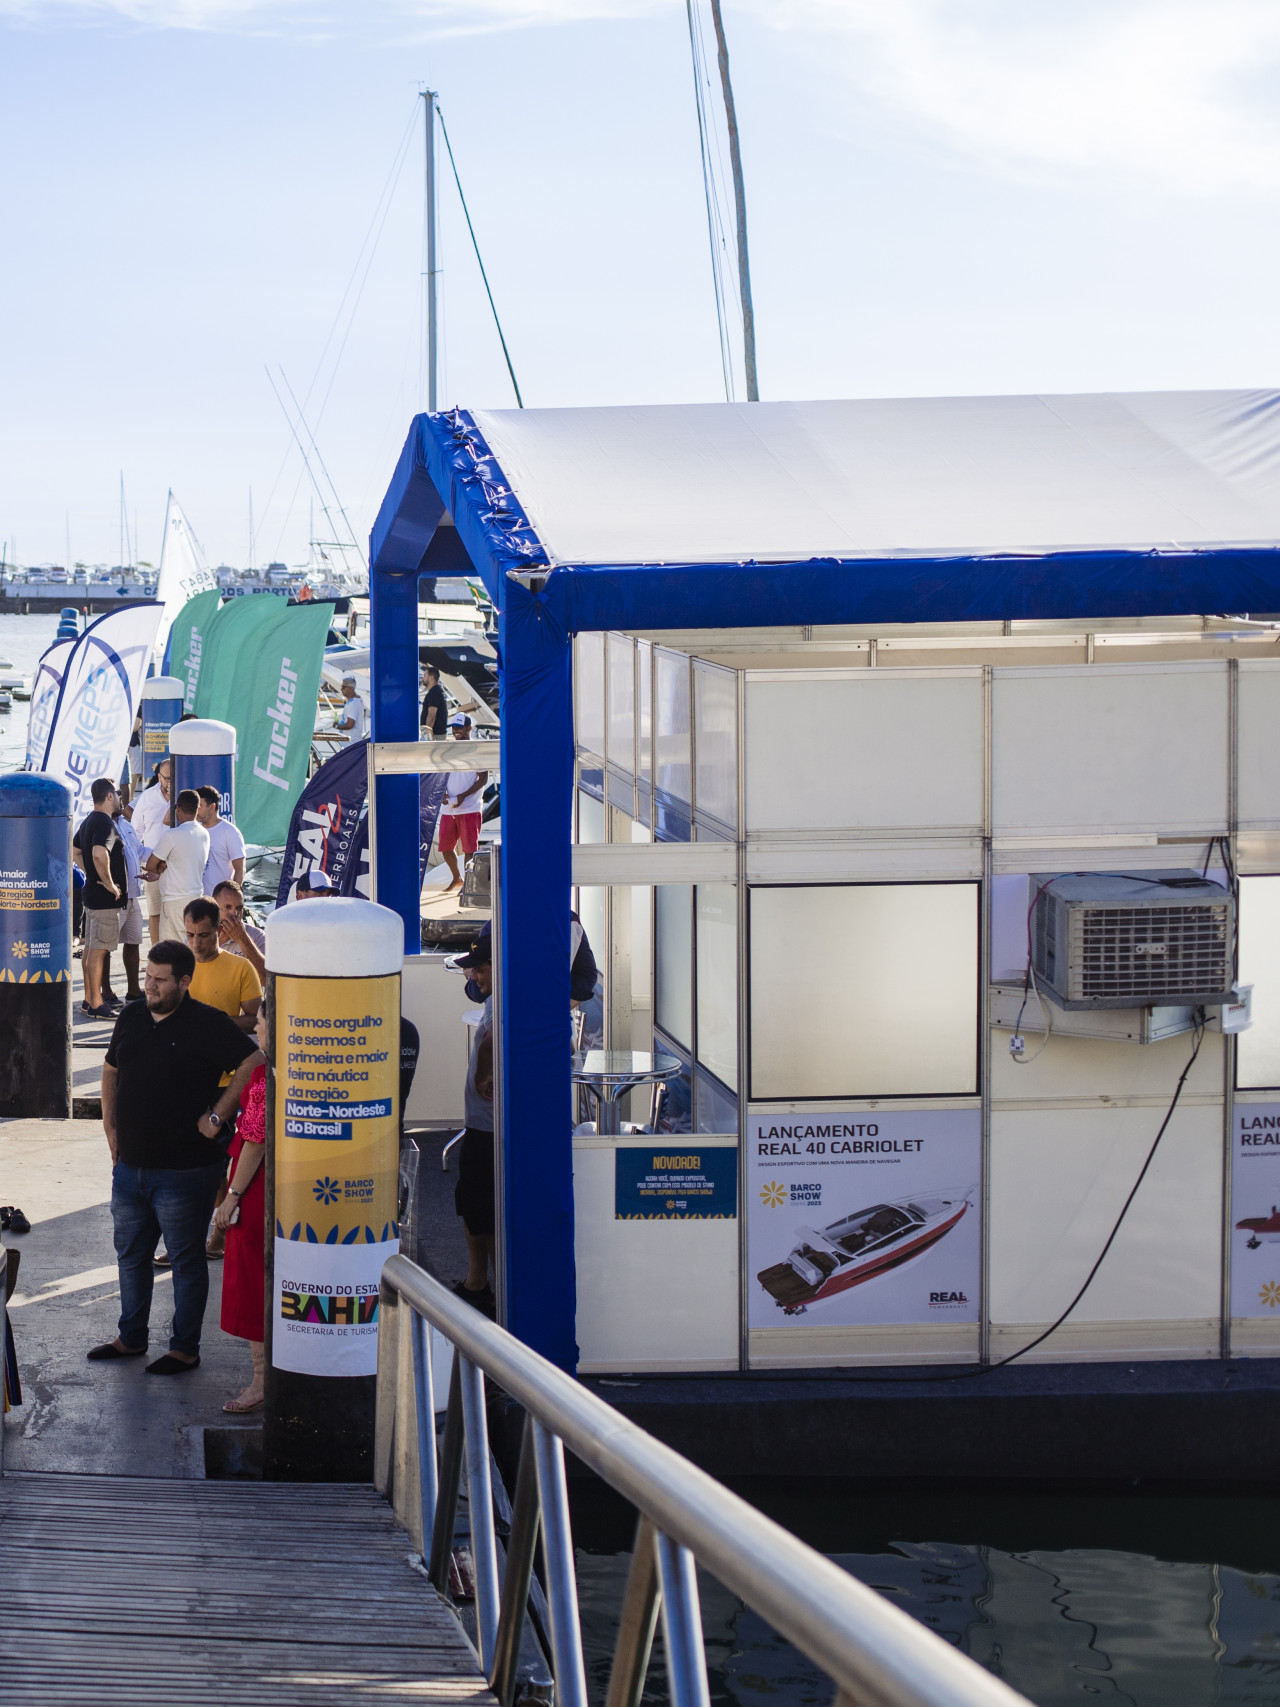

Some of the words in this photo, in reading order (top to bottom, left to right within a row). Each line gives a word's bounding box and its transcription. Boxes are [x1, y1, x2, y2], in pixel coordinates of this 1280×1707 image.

[253, 657, 298, 791] Focker
[2, 869, 28, 879] maior
[14, 879, 48, 889] náutica
[7, 890, 33, 900] região
[288, 1014, 332, 1028] Temos
[333, 1015, 383, 1032] orgulho
[288, 1032, 303, 1045] de
[304, 1035, 356, 1046] sermos
[357, 1036, 367, 1046] a
[288, 1049, 344, 1065] primeira
[345, 1054, 354, 1064] e
[355, 1049, 389, 1063] maior
[288, 1067, 315, 1081] feira
[316, 1068, 369, 1082] náutica
[288, 1085, 304, 1098] da
[305, 1086, 350, 1103] região
[287, 1120, 303, 1134] do
[303, 1121, 342, 1136] Brasil
[758, 1123, 879, 1142] LANÇAMENTO
[758, 1143, 802, 1156] REAL
[805, 1142, 826, 1155] 40
[831, 1139, 924, 1154] CABRIOLET
[652, 1155, 701, 1170] NOVIDADE!
[344, 1179, 374, 1188] BARCO
[790, 1183, 822, 1191] BARCO
[344, 1188, 374, 1198] SHOW
[790, 1192, 822, 1200] SHOW
[282, 1280, 333, 1295] GOVERNO
[336, 1285, 352, 1295] DO
[355, 1284, 380, 1295] ESTA
[930, 1291, 968, 1302] REAL
[287, 1324, 334, 1336] SECRETARIA
[337, 1328, 348, 1336] DE
[351, 1327, 378, 1336] TURISM
